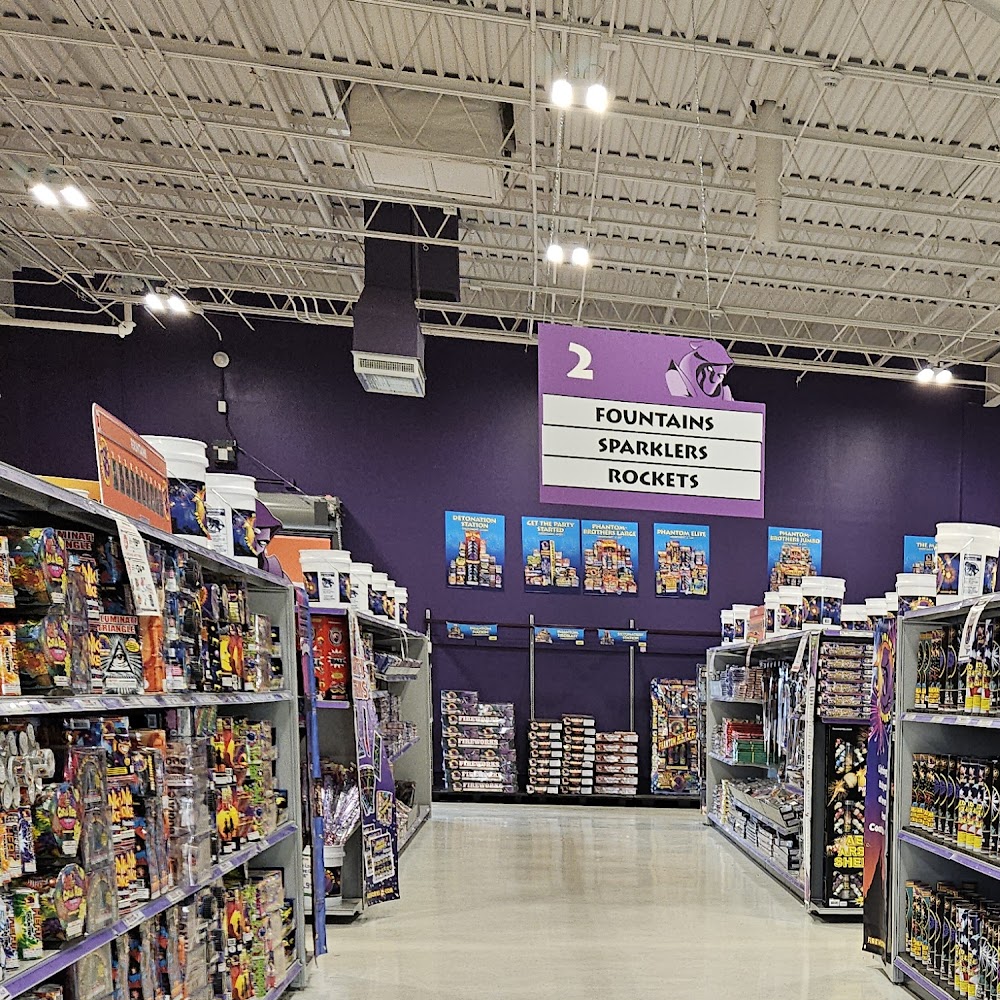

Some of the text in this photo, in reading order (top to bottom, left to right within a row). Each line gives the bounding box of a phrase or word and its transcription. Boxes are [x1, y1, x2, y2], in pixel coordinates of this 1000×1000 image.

[566, 342, 594, 380] 2
[596, 407, 714, 431] FOUNTAINS
[598, 438, 708, 460] SPARKLERS
[608, 468, 699, 488] ROCKETS
[452, 515, 497, 524] DETONATION
